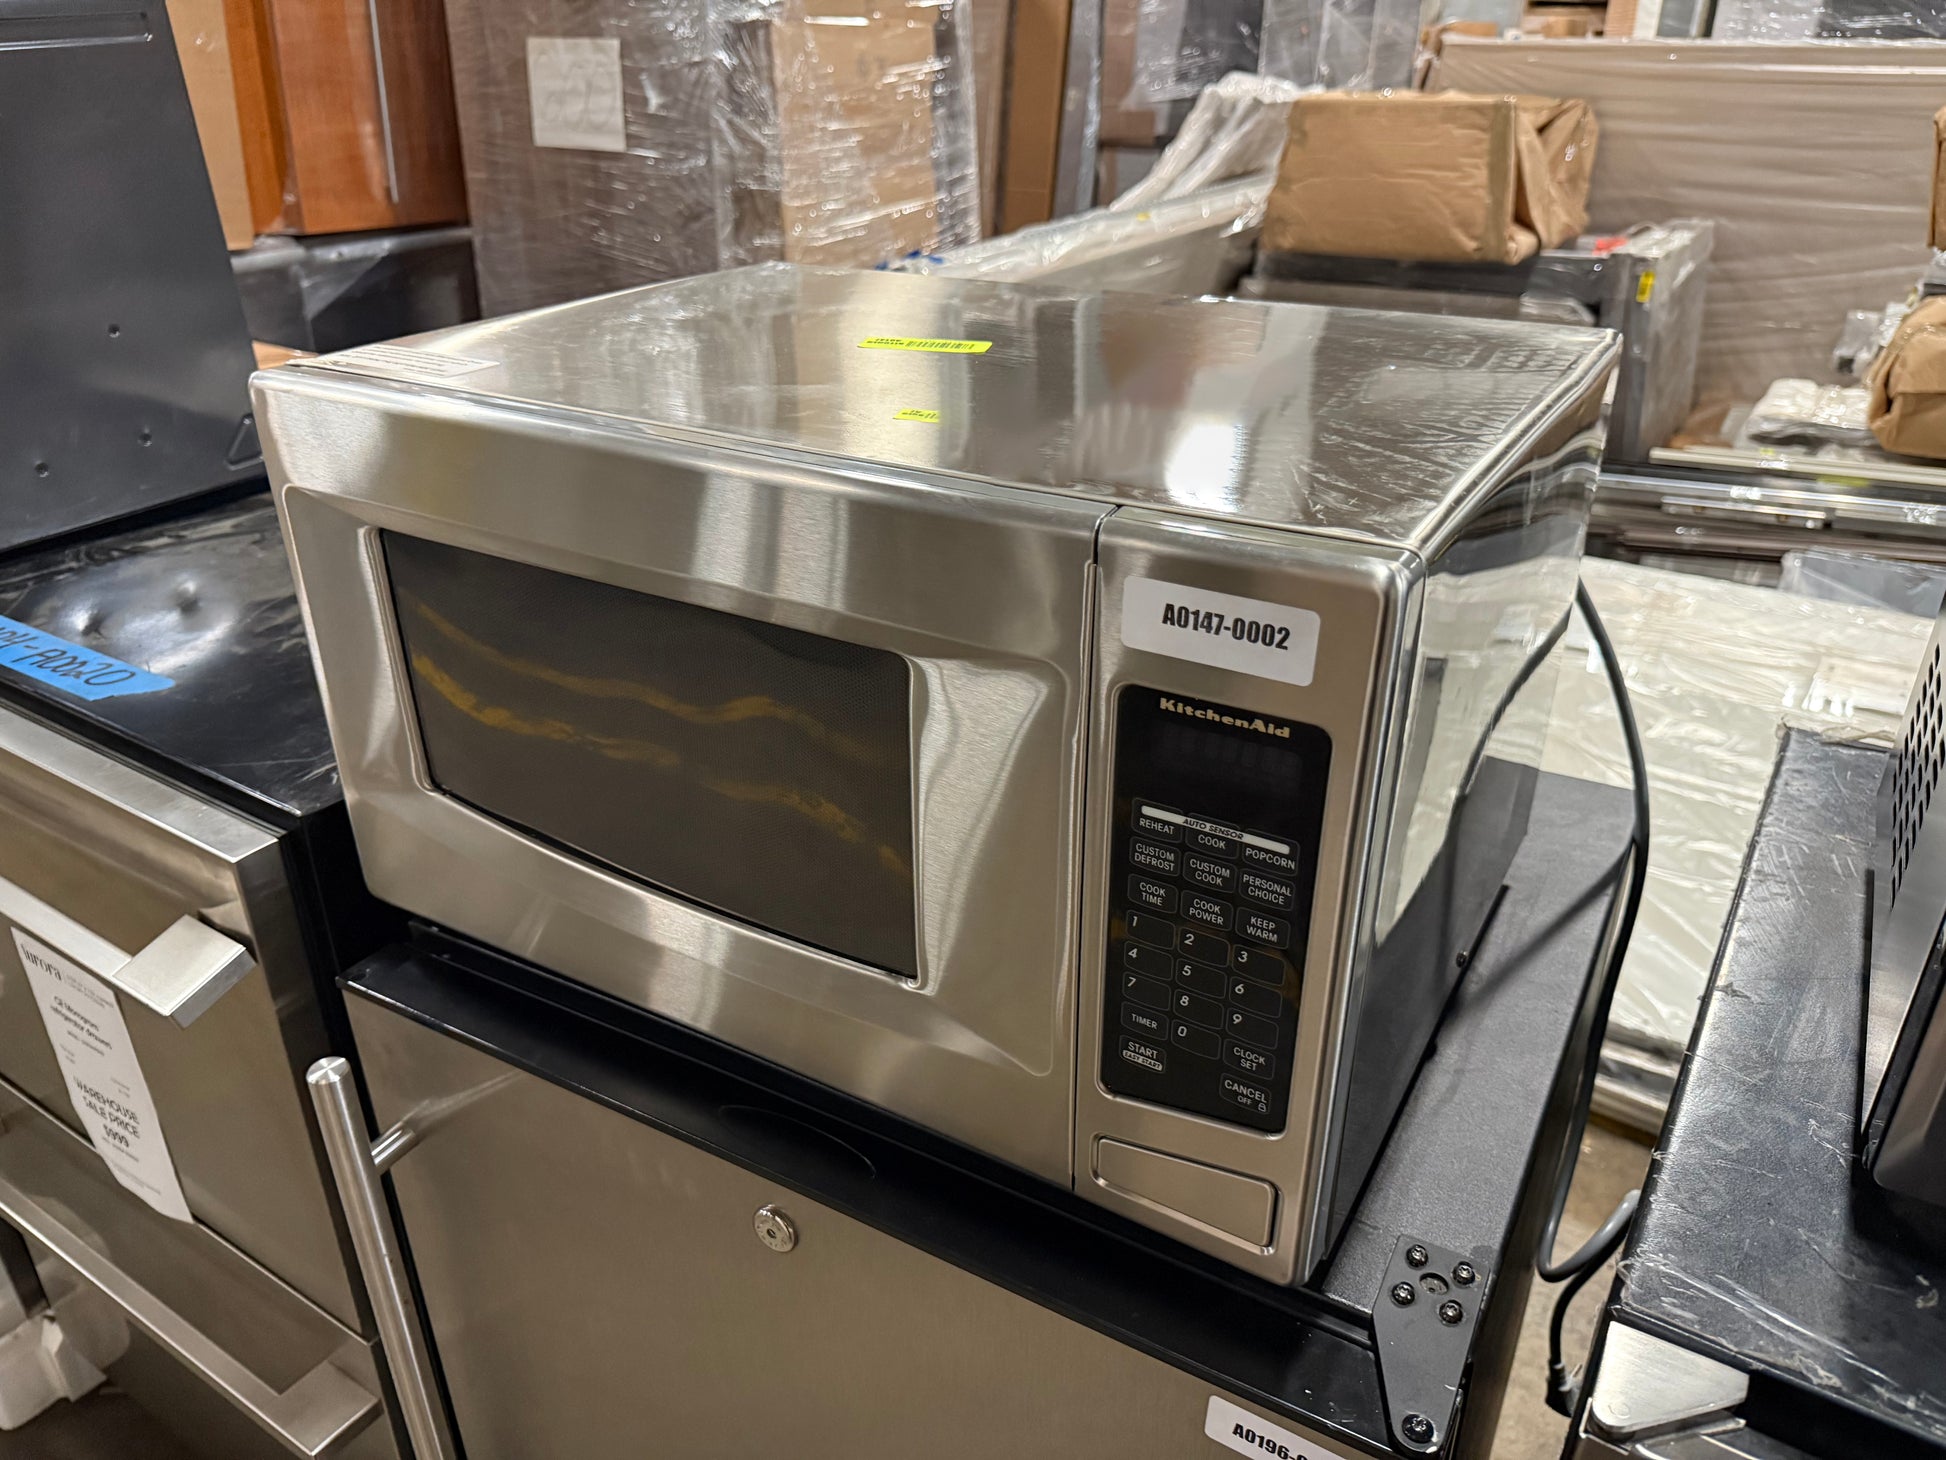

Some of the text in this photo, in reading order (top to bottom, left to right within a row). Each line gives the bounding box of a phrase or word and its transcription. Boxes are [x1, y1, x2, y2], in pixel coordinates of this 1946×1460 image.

[1162, 603, 1290, 650] A0147-0002
[1159, 697, 1291, 739] KitchenAid
[1139, 818, 1174, 835] REHEAT
[1183, 818, 1244, 840] AUTO SENSOR
[1198, 834, 1226, 849] COOK
[1135, 843, 1175, 861] CUSTOM
[1245, 847, 1296, 870] POPCORN
[1134, 853, 1175, 871] DEFROST
[1190, 858, 1230, 878] CUSTOM
[1195, 871, 1223, 886] COOK
[1243, 874, 1292, 896] PERSONAL
[1139, 882, 1166, 897] COOK
[1248, 887, 1285, 905] CHOICE
[1141, 892, 1163, 906] TIME
[1193, 898, 1221, 914] COOK
[1132, 915, 1138, 927] 1
[1189, 908, 1224, 925] POWER
[1250, 916, 1276, 931] KEEP
[1183, 933, 1195, 945] 2
[1246, 925, 1278, 943] WARM
[1128, 948, 1138, 959] 4
[1237, 951, 1248, 963] 3
[1182, 965, 1192, 976] 5
[1127, 977, 1137, 987] 7
[1234, 983, 1245, 995] 6
[1179, 995, 1190, 1007] 8
[1131, 1013, 1158, 1030] TIMER
[1232, 1013, 1243, 1025] 9
[1177, 1026, 1187, 1037] 0
[1128, 1041, 1158, 1059] START
[1233, 1047, 1266, 1066] CLOCK
[1142, 1057, 1160, 1069] START
[1240, 1059, 1257, 1071] SET
[1224, 1079, 1267, 1103] CANCEL
[73, 1076, 140, 1125] WAREHOUSE
[1237, 1095, 1253, 1105] OFF
[83, 1095, 140, 1139] SALE PRICE
